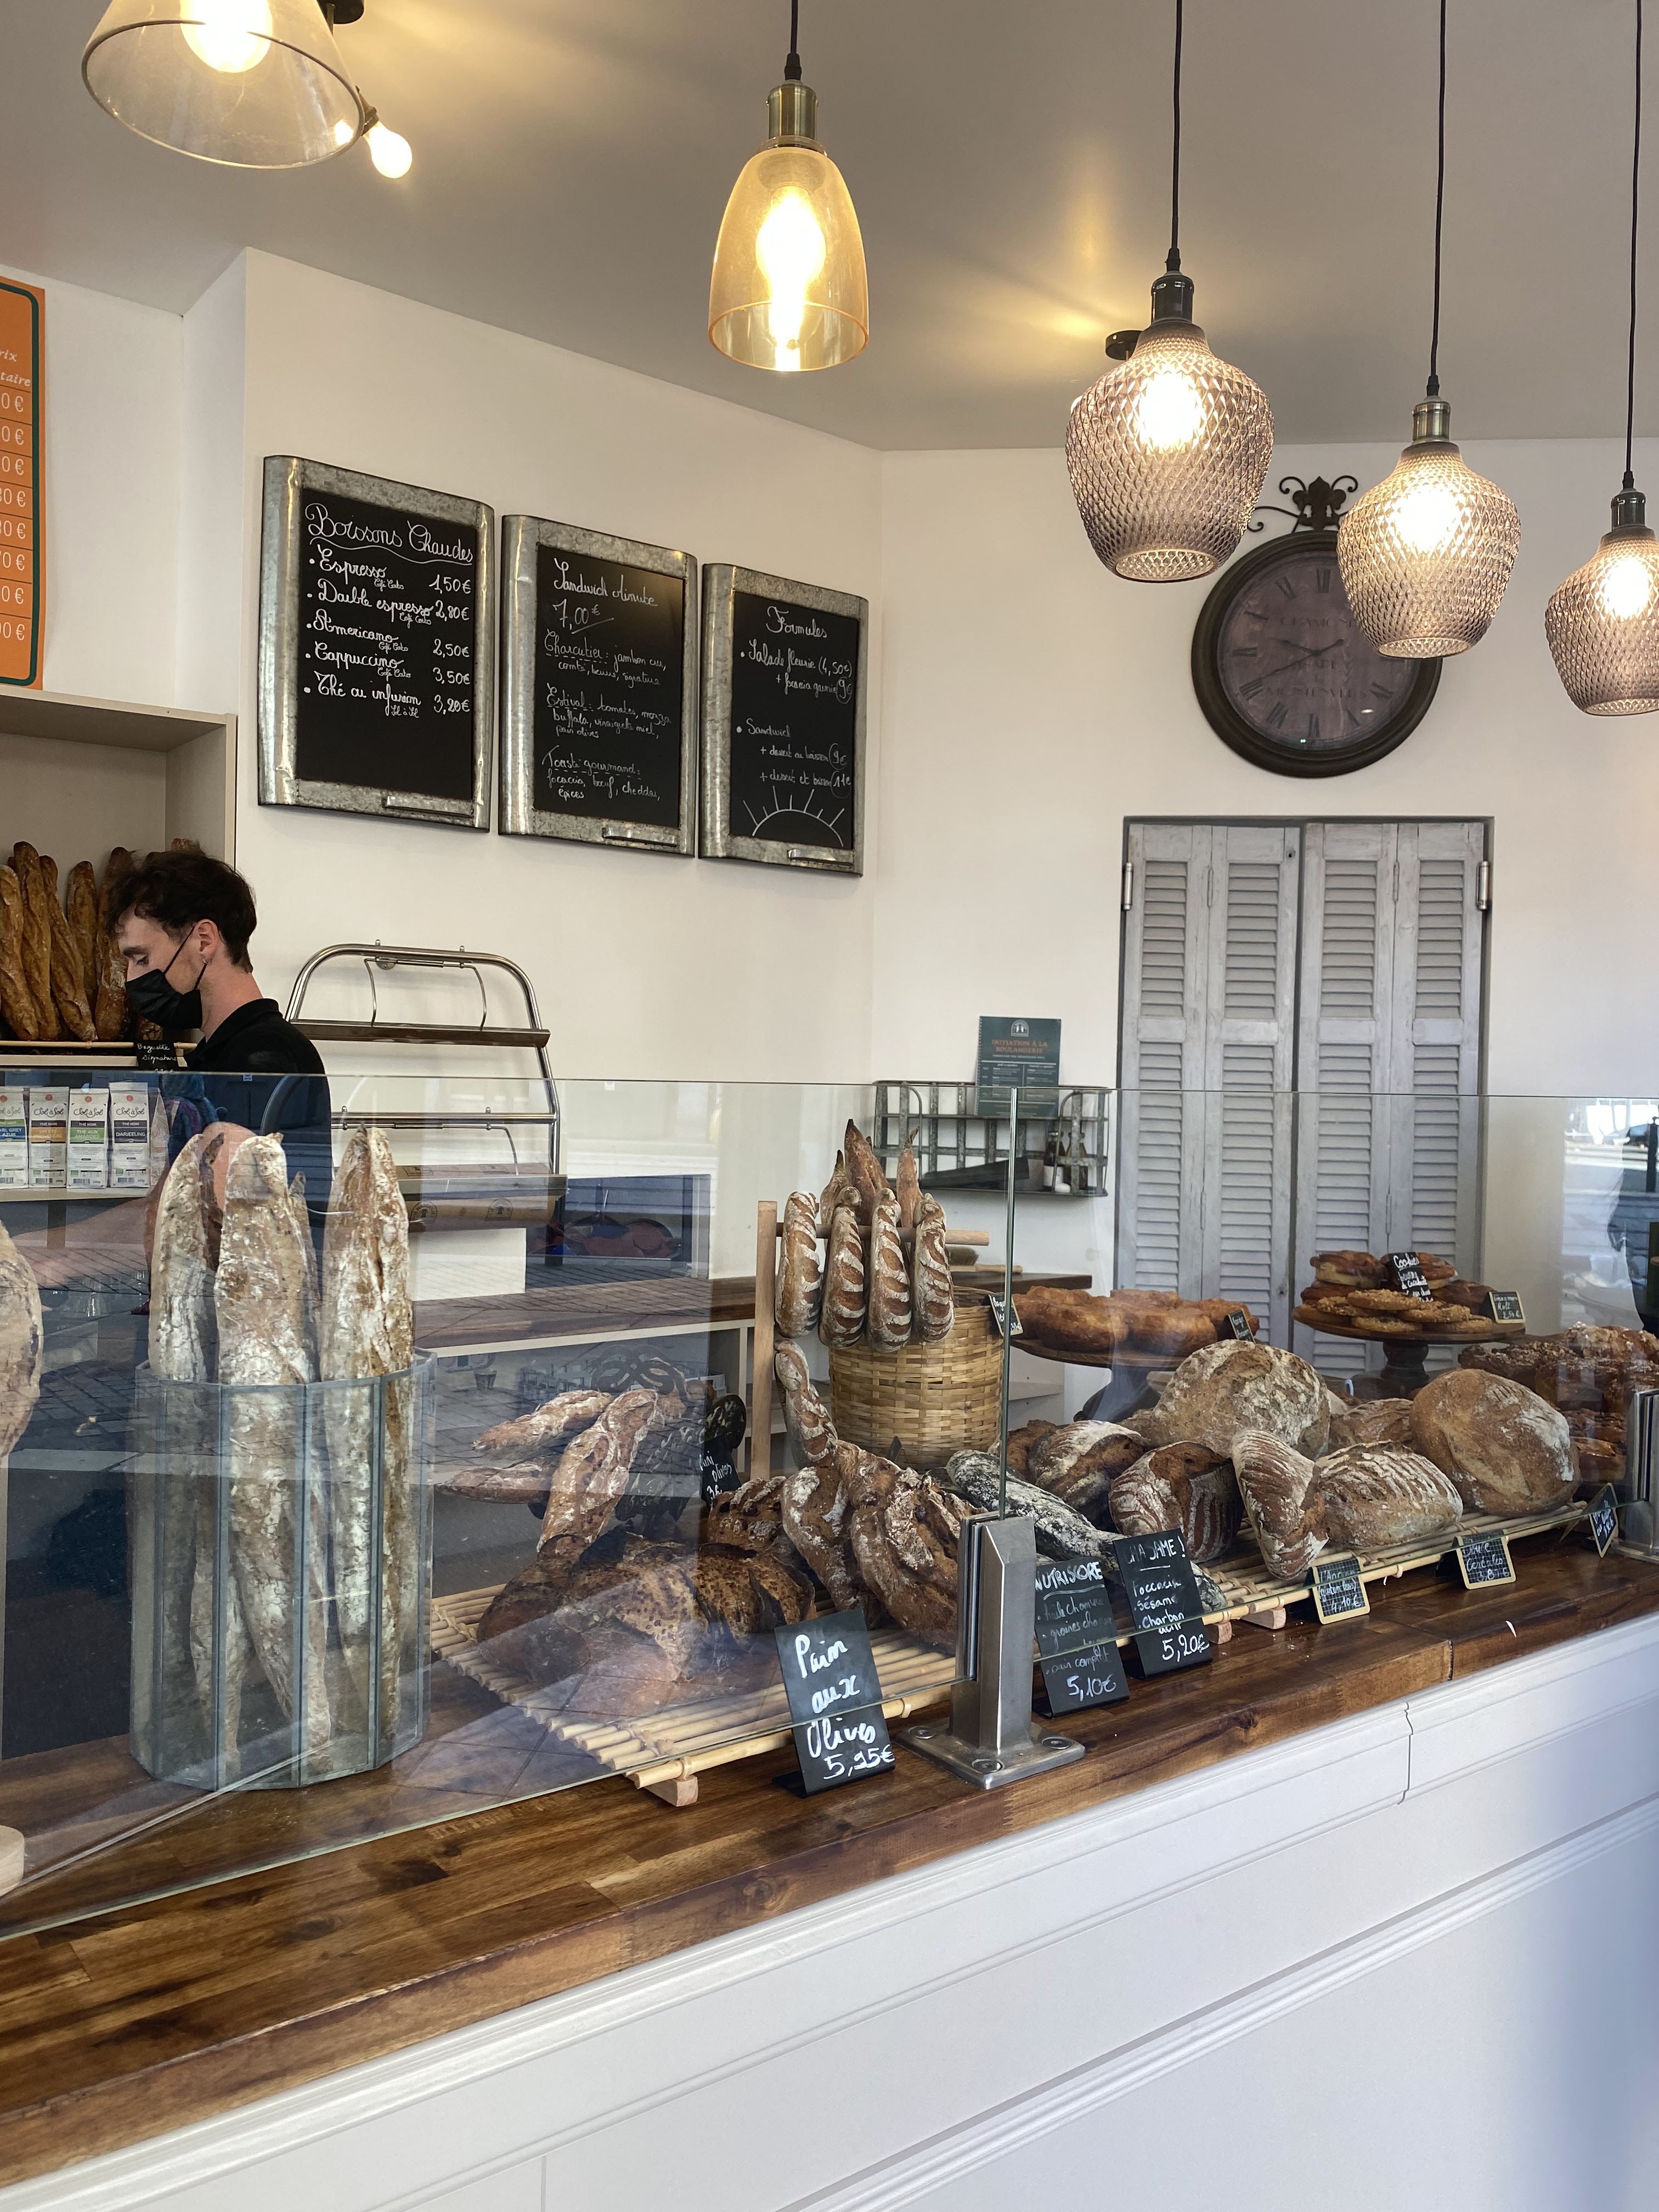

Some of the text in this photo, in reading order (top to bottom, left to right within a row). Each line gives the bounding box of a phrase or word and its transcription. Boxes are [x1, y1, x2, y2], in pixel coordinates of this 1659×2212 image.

[306, 503, 473, 563] Boissons Chaudes
[318, 544, 471, 594] Espresso 1,50€
[554, 557, 608, 597] Sandwich
[376, 600, 433, 623] espresso
[435, 600, 470, 622] 2,80€
[552, 599, 601, 630] 7,00€
[765, 605, 827, 638] Formules
[313, 608, 470, 658] Americano 2,50€
[315, 641, 470, 685] Cappuccino 3,50€
[614, 645, 646, 673] jambon
[748, 639, 785, 667] Salade
[786, 648, 816, 673] fleurie
[314, 670, 470, 716] Thé ou infusion 3,20€
[556, 725, 600, 738] pain olives
[558, 785, 585, 802] épices
[795, 1634, 848, 1679] Pain
[811, 1674, 860, 1714] aux
[1066, 1673, 1117, 1701] 5,10€
[806, 1716, 876, 1758] Olives
